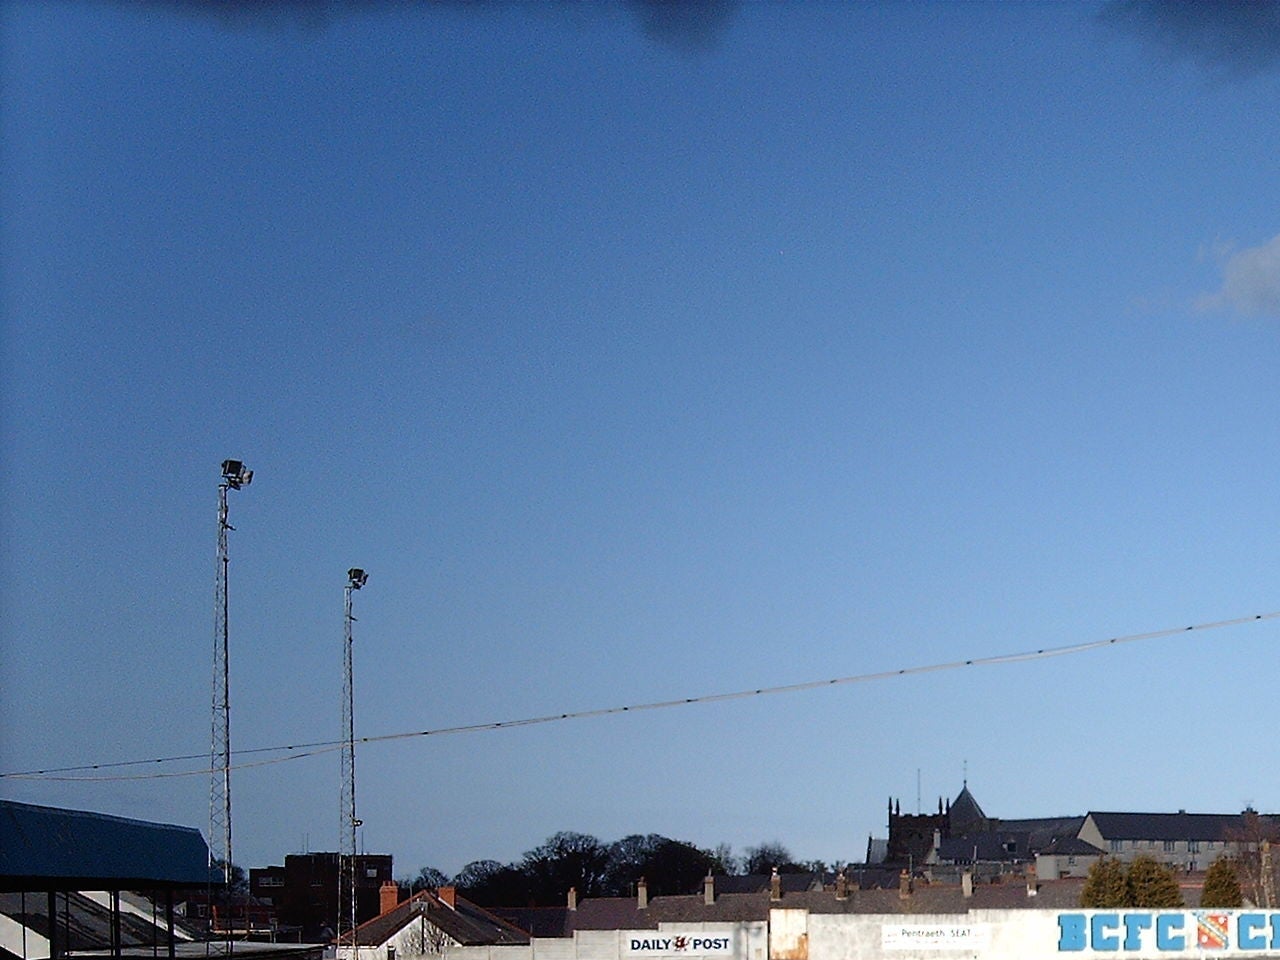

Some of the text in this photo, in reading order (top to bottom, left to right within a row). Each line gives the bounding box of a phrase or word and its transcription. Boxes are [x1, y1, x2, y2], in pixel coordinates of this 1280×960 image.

[901, 928, 971, 938] Pentraeth SEAT
[1057, 913, 1186, 951] BCFC
[631, 938, 729, 950] DAILY POST
